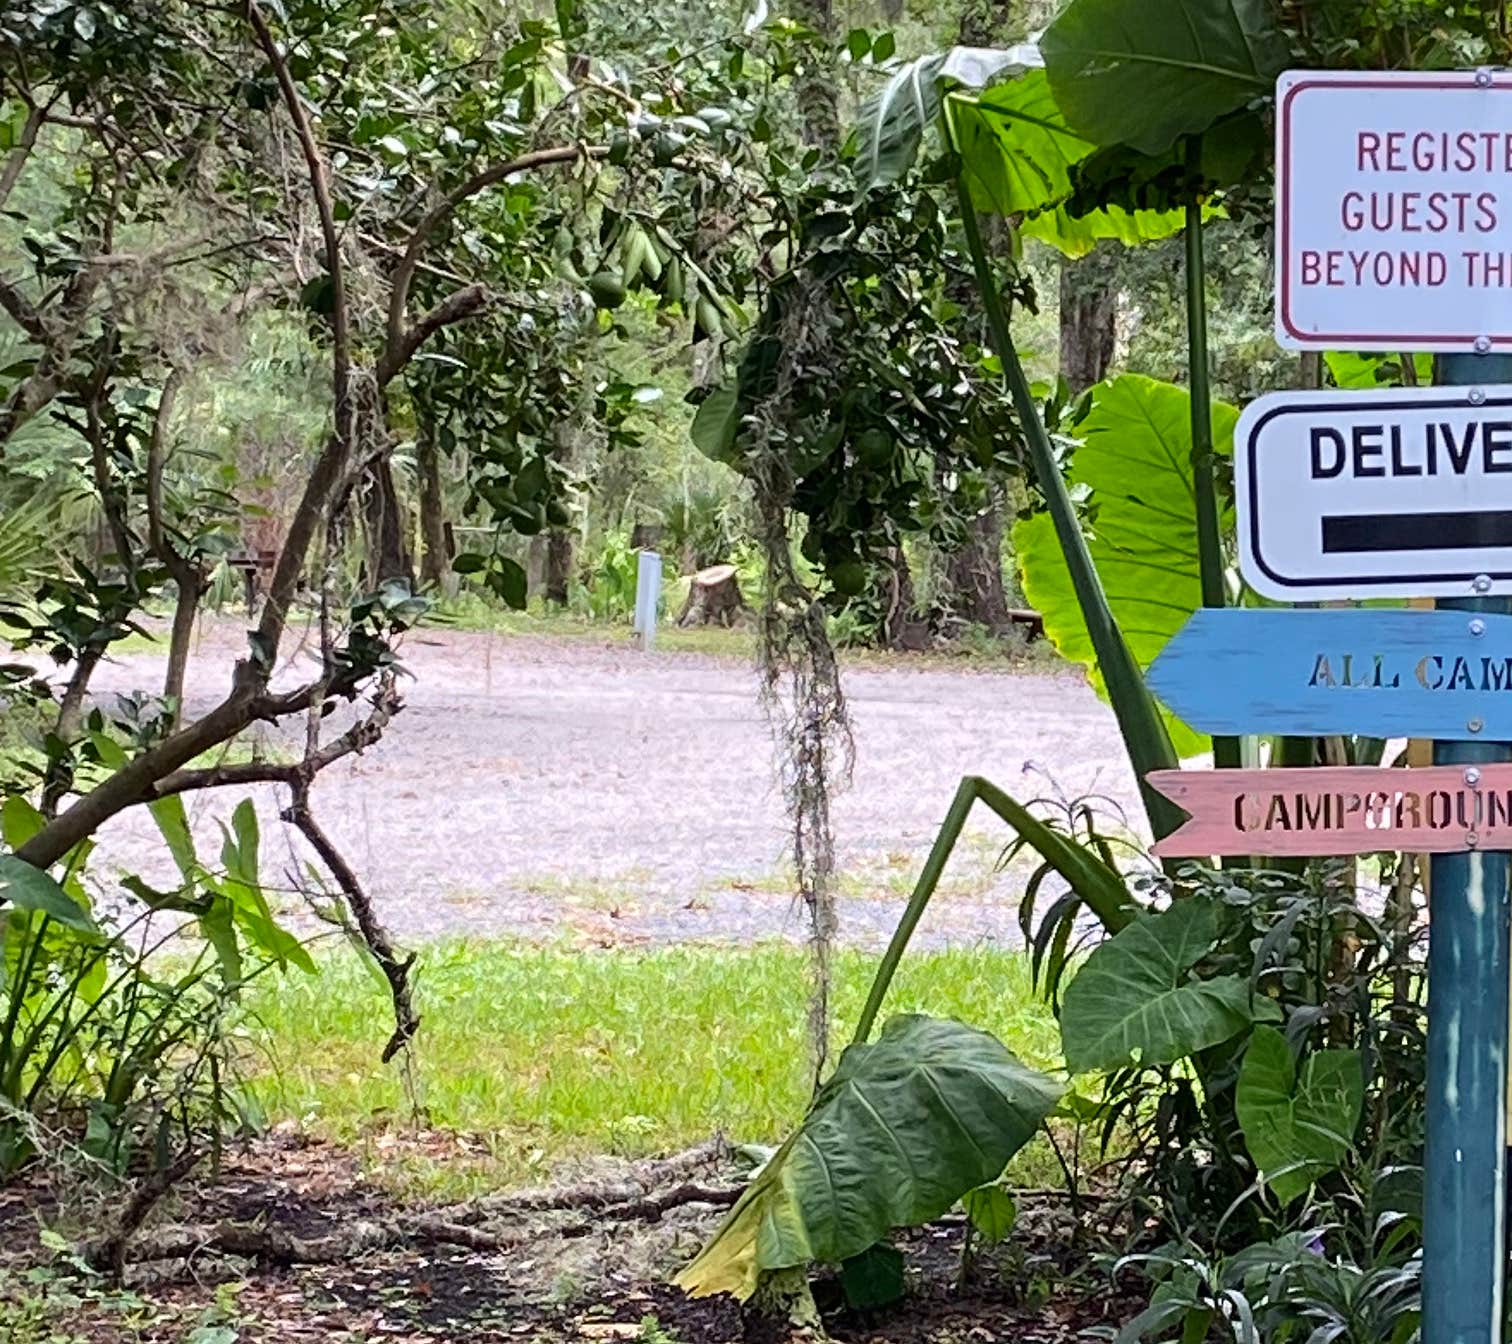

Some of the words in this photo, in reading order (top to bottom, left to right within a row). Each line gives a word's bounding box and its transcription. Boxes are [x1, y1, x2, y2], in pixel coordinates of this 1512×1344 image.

[1341, 191, 1497, 233] GUESTS
[1301, 250, 1447, 287] BEYOND
[1308, 653, 1400, 690] ALL
